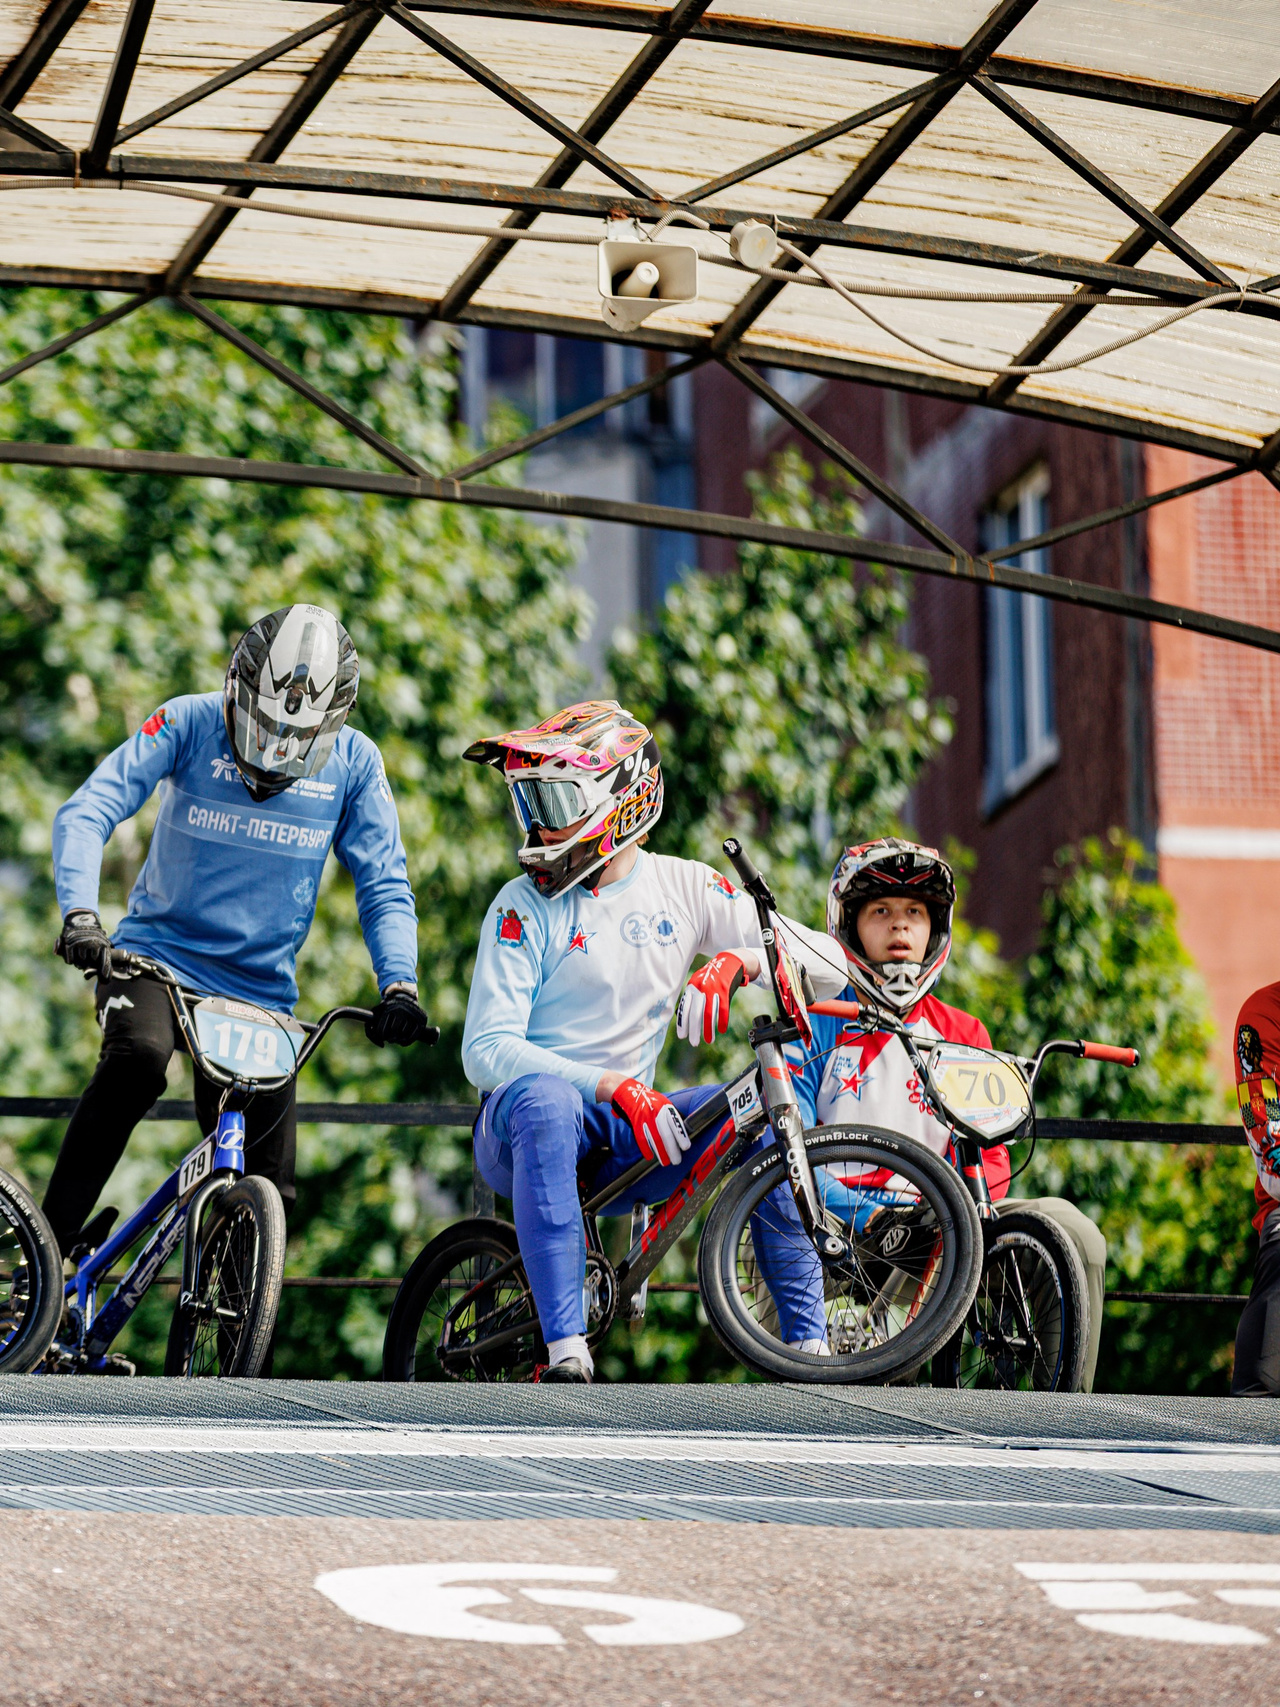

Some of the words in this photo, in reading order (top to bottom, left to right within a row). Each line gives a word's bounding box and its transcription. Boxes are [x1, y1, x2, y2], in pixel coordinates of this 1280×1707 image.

[291, 778, 337, 794] ETERHOF
[187, 804, 333, 850] САНКТ-ПЕТЕРБУРГ
[214, 1021, 278, 1067] 179
[732, 1086, 754, 1117] 705
[958, 1068, 1007, 1106] 70
[183, 1151, 206, 1188] 179
[640, 1118, 737, 1255] MEYBO
[313, 1561, 746, 1646] 6
